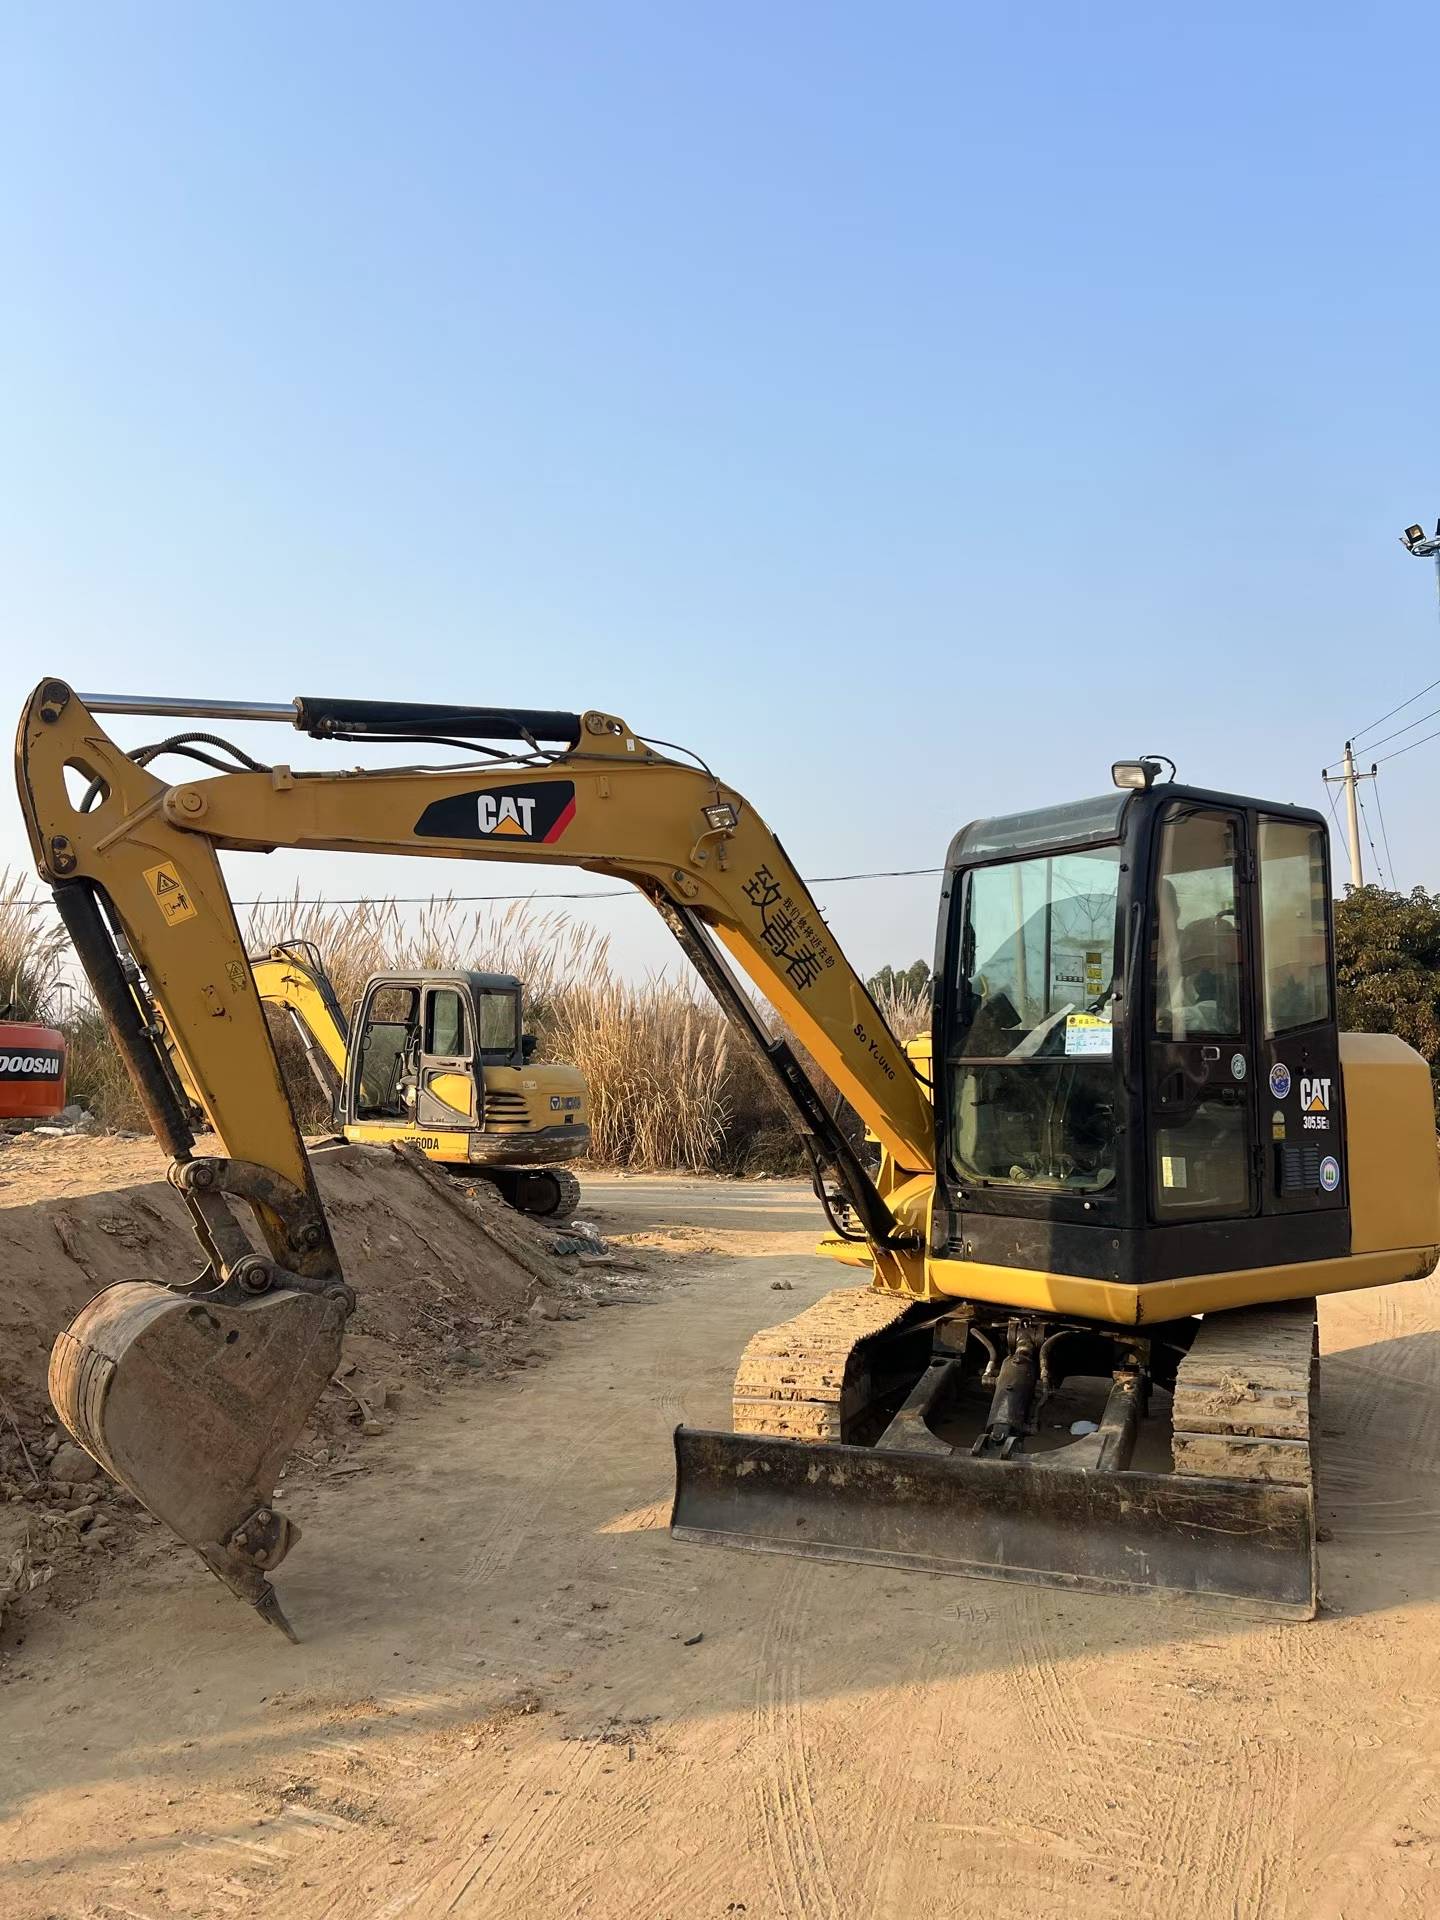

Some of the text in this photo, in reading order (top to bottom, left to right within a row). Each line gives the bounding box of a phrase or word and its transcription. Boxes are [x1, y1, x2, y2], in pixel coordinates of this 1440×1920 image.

[477, 795, 536, 836] CAT
[741, 864, 823, 990] 致青春
[1300, 1078, 1331, 1111] CAT
